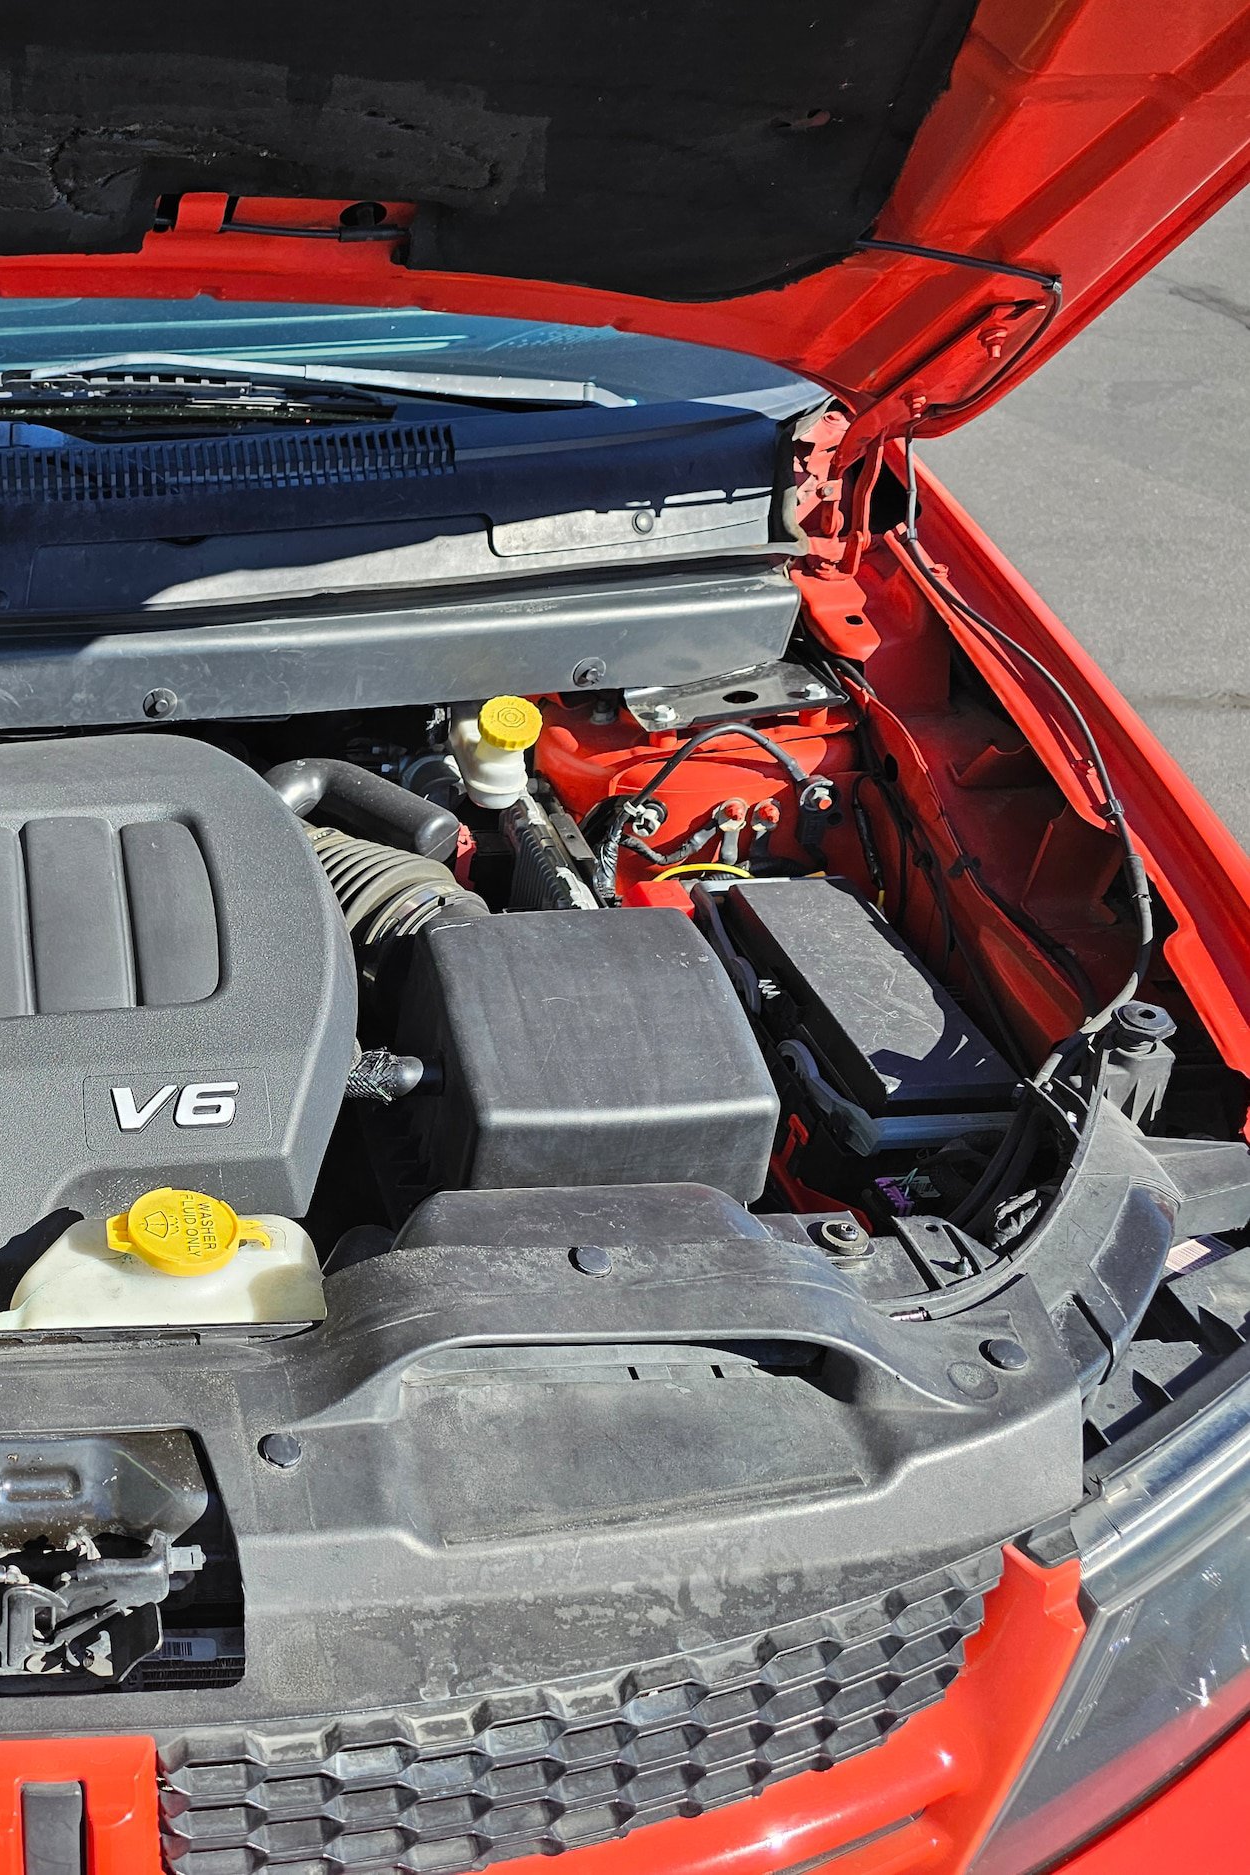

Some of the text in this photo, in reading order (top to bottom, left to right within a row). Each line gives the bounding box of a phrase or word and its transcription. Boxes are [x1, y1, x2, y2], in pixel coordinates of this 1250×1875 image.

[110, 1081, 240, 1133] V6
[179, 1193, 202, 1257] FLUID ONLY
[197, 1201, 217, 1250] WASHER
